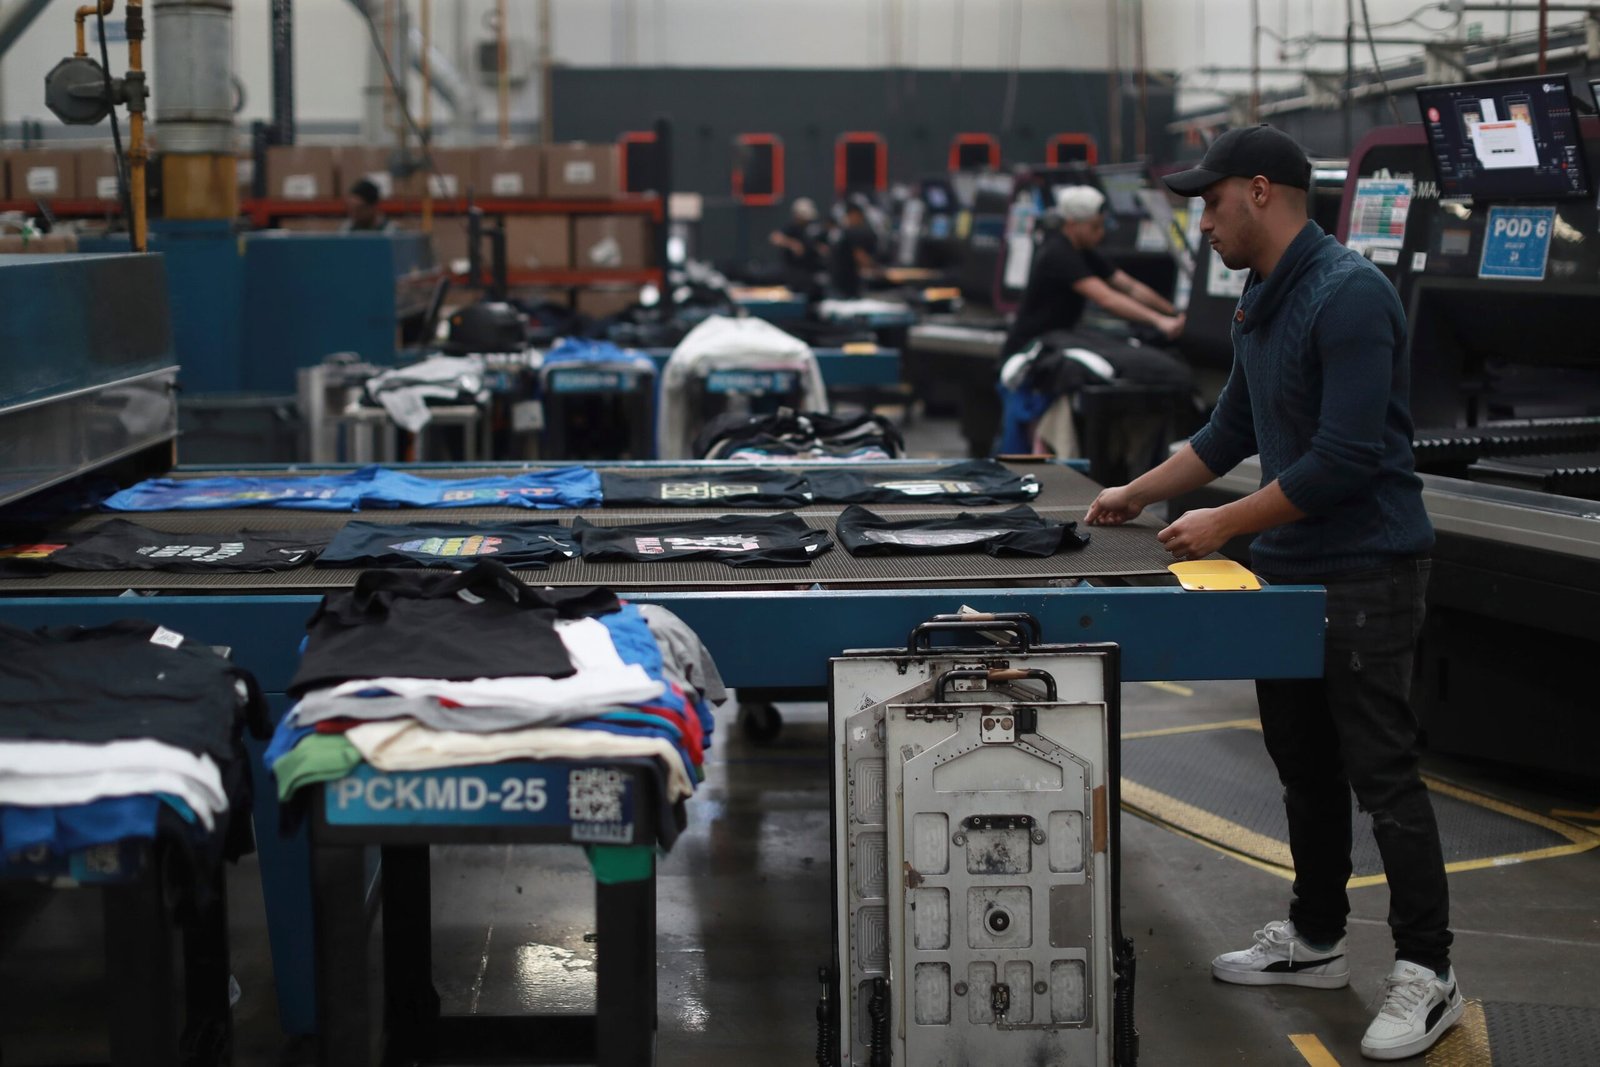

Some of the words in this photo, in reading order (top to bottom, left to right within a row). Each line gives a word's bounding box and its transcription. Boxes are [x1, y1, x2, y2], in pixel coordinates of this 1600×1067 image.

[1493, 217, 1532, 238] POD
[1535, 219, 1548, 239] 6
[337, 776, 547, 811] PCKMD-25
